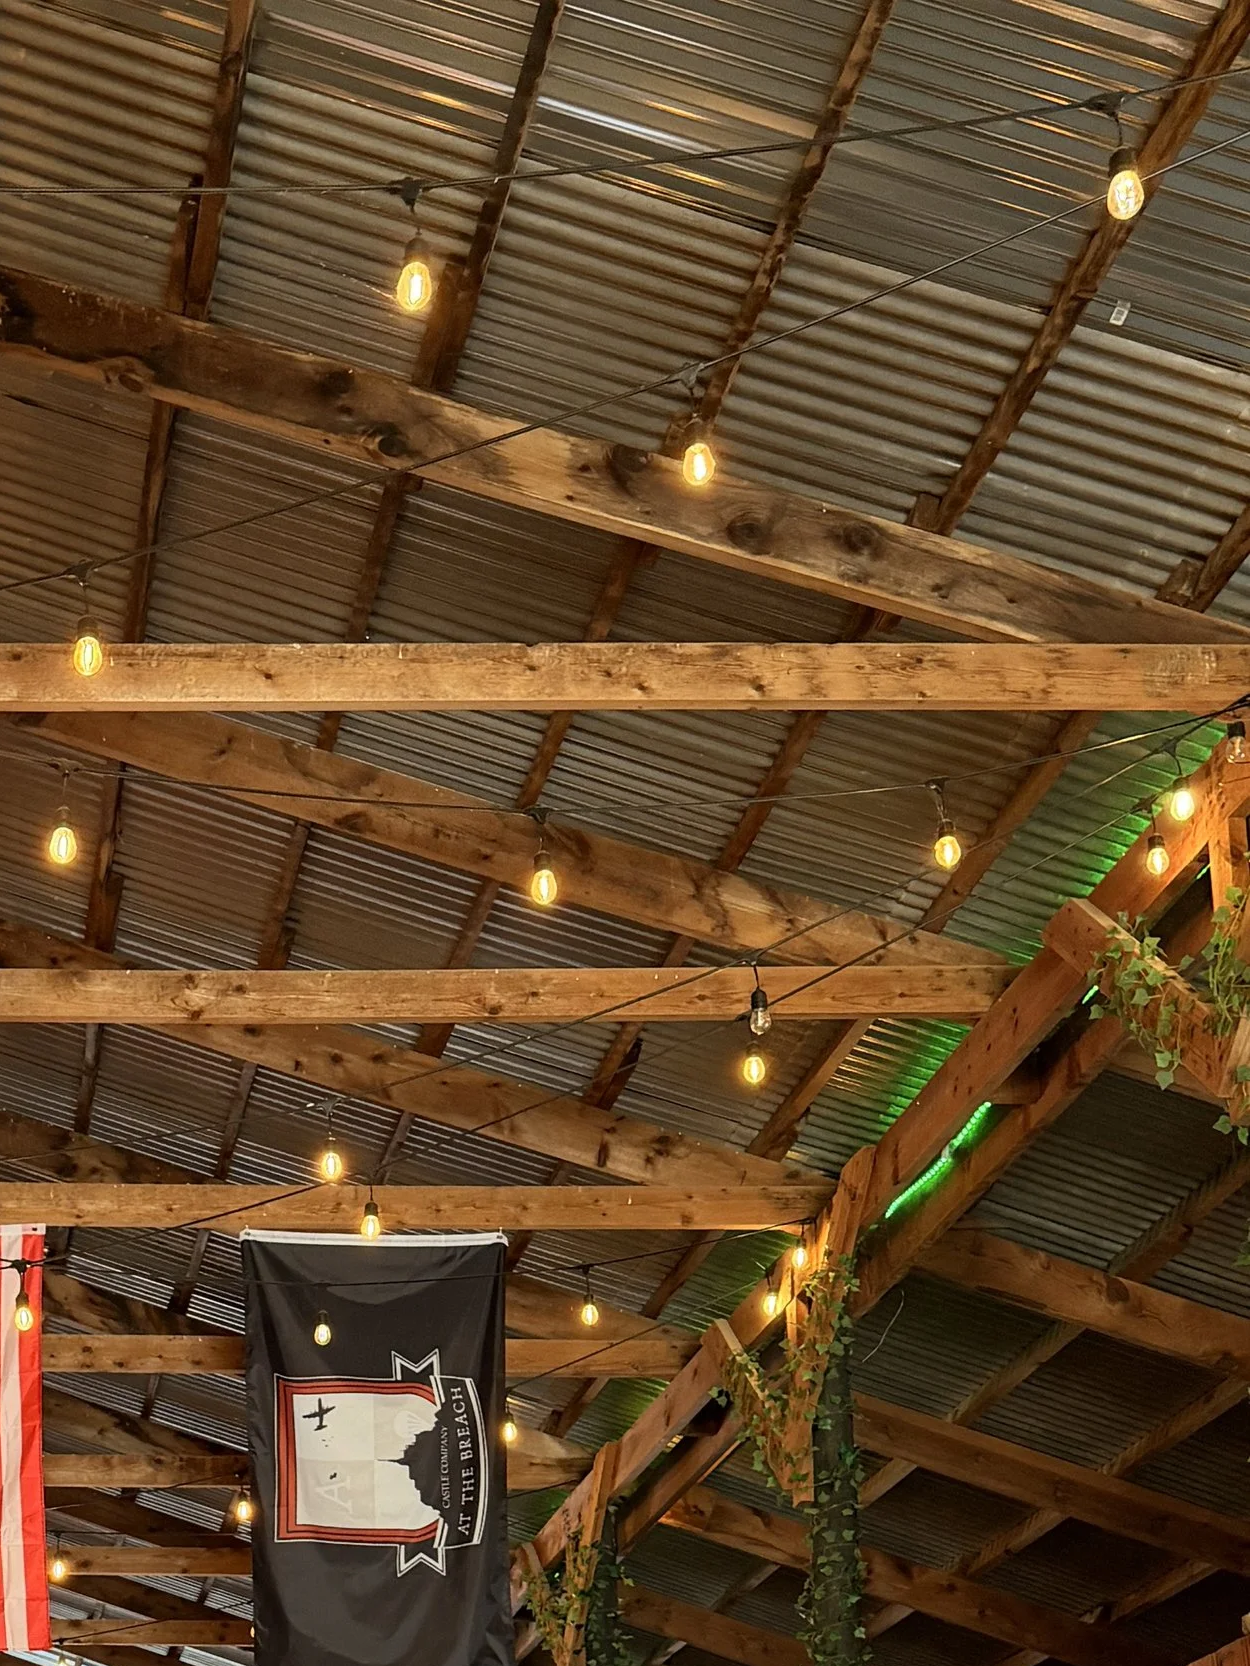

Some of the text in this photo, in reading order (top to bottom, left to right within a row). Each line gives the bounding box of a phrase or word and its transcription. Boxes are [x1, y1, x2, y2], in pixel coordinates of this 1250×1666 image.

[440, 1425, 450, 1509] CASTLE COMPANY
[450, 1387, 474, 1535] AT THE BREACH
